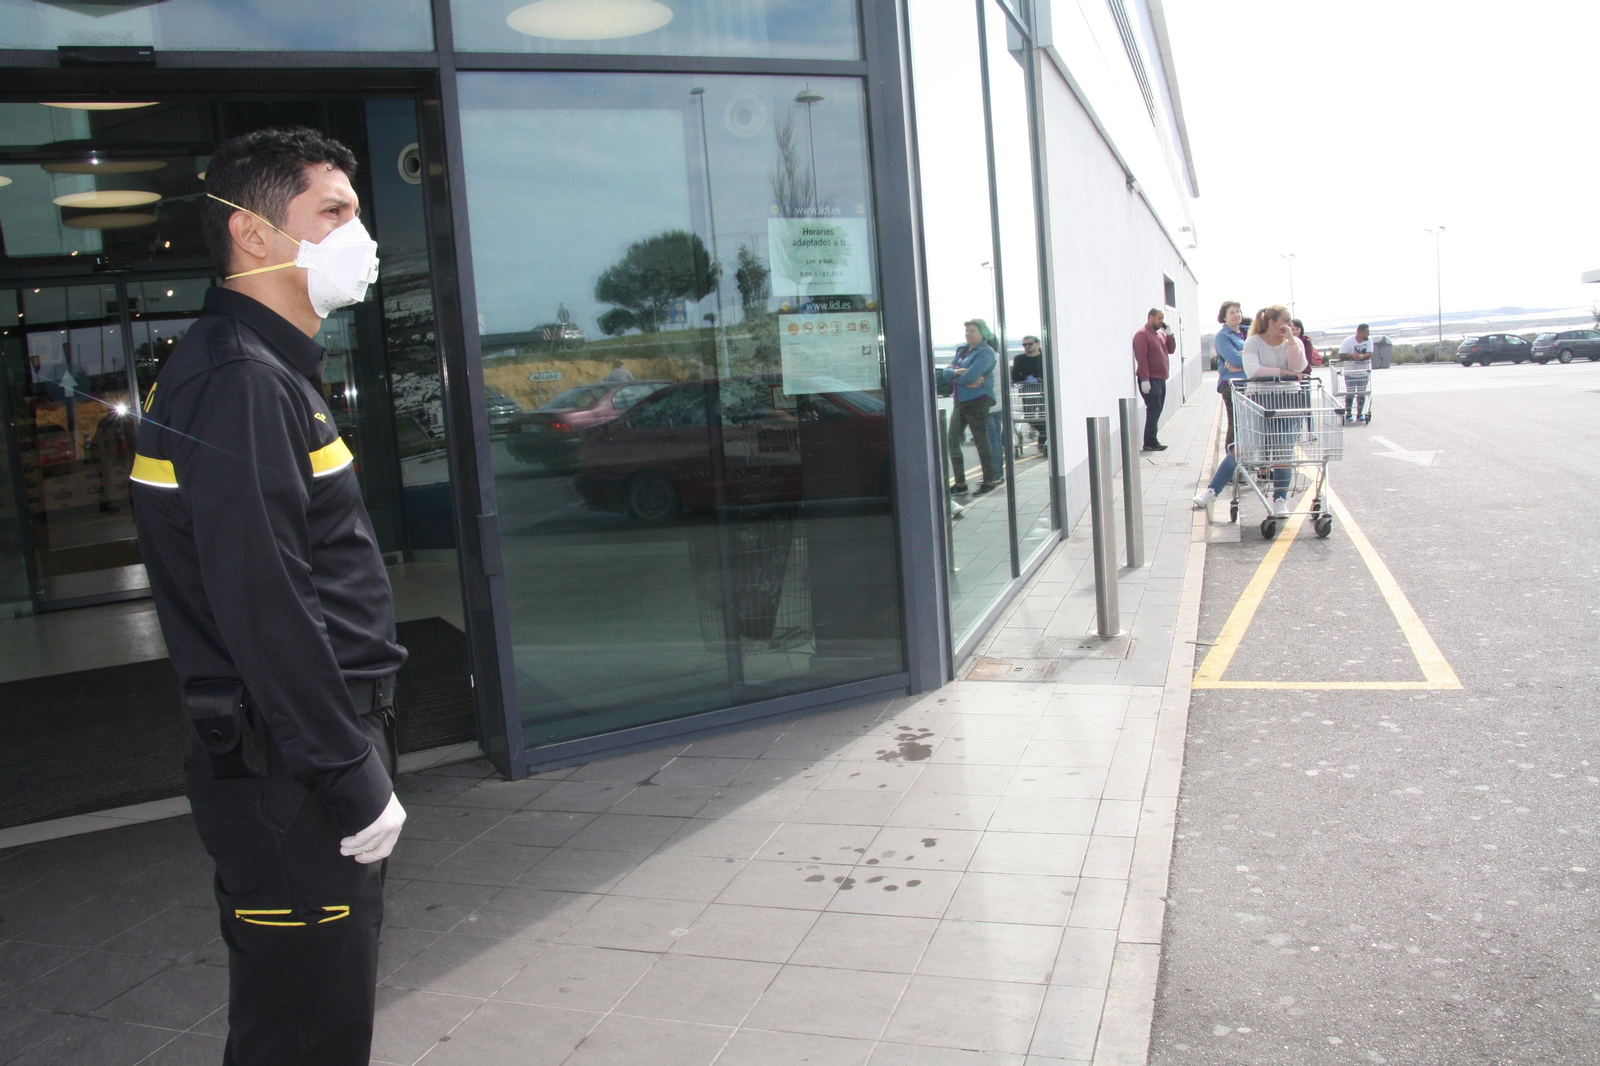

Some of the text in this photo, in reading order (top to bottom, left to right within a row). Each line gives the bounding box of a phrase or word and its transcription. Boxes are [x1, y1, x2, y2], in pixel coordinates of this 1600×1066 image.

[795, 205, 841, 215] www.lidl.es
[802, 227, 834, 236] Horarios
[792, 238, 831, 248] adaptados
[806, 301, 851, 311] www.lidl.es
